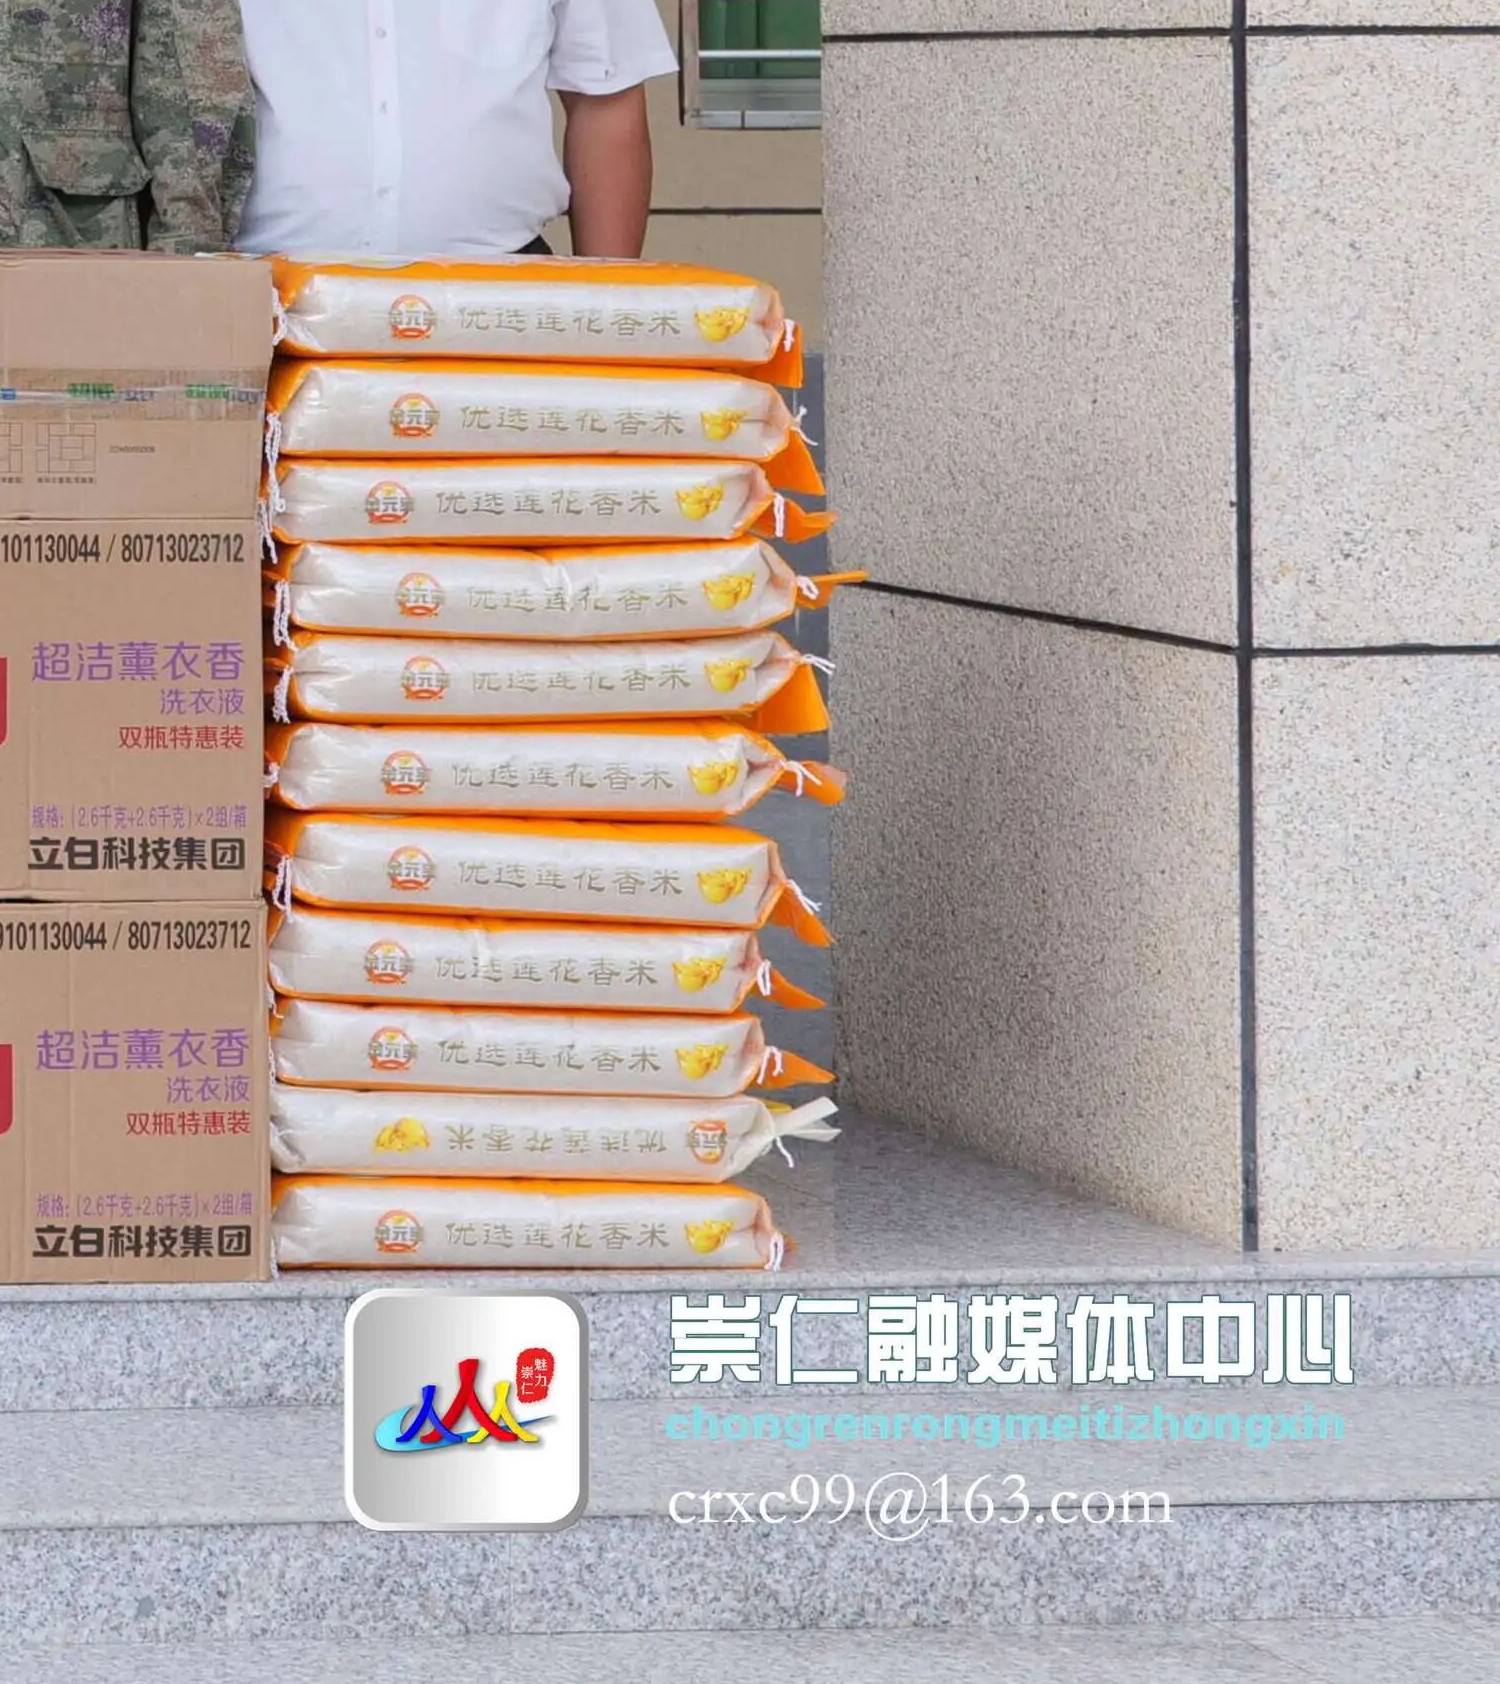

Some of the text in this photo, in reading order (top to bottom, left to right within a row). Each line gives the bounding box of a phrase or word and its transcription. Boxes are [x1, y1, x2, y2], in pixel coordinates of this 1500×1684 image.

[121, 533, 244, 562] 80713023712
[31, 641, 245, 682] 超洁薰衣香
[159, 688, 245, 715] 洗衣液
[118, 725, 244, 750] 双瓶特惠装
[28, 837, 245, 870] 立白科技集团
[459, 859, 684, 897] 优选莲花香米
[127, 920, 251, 949] 80713023712
[36, 1028, 249, 1070] 超洁薰衣香
[166, 1075, 251, 1103] 洗衣液
[125, 1111, 251, 1136] 双瓶特惠装
[32, 1225, 252, 1258] 立白科技集团
